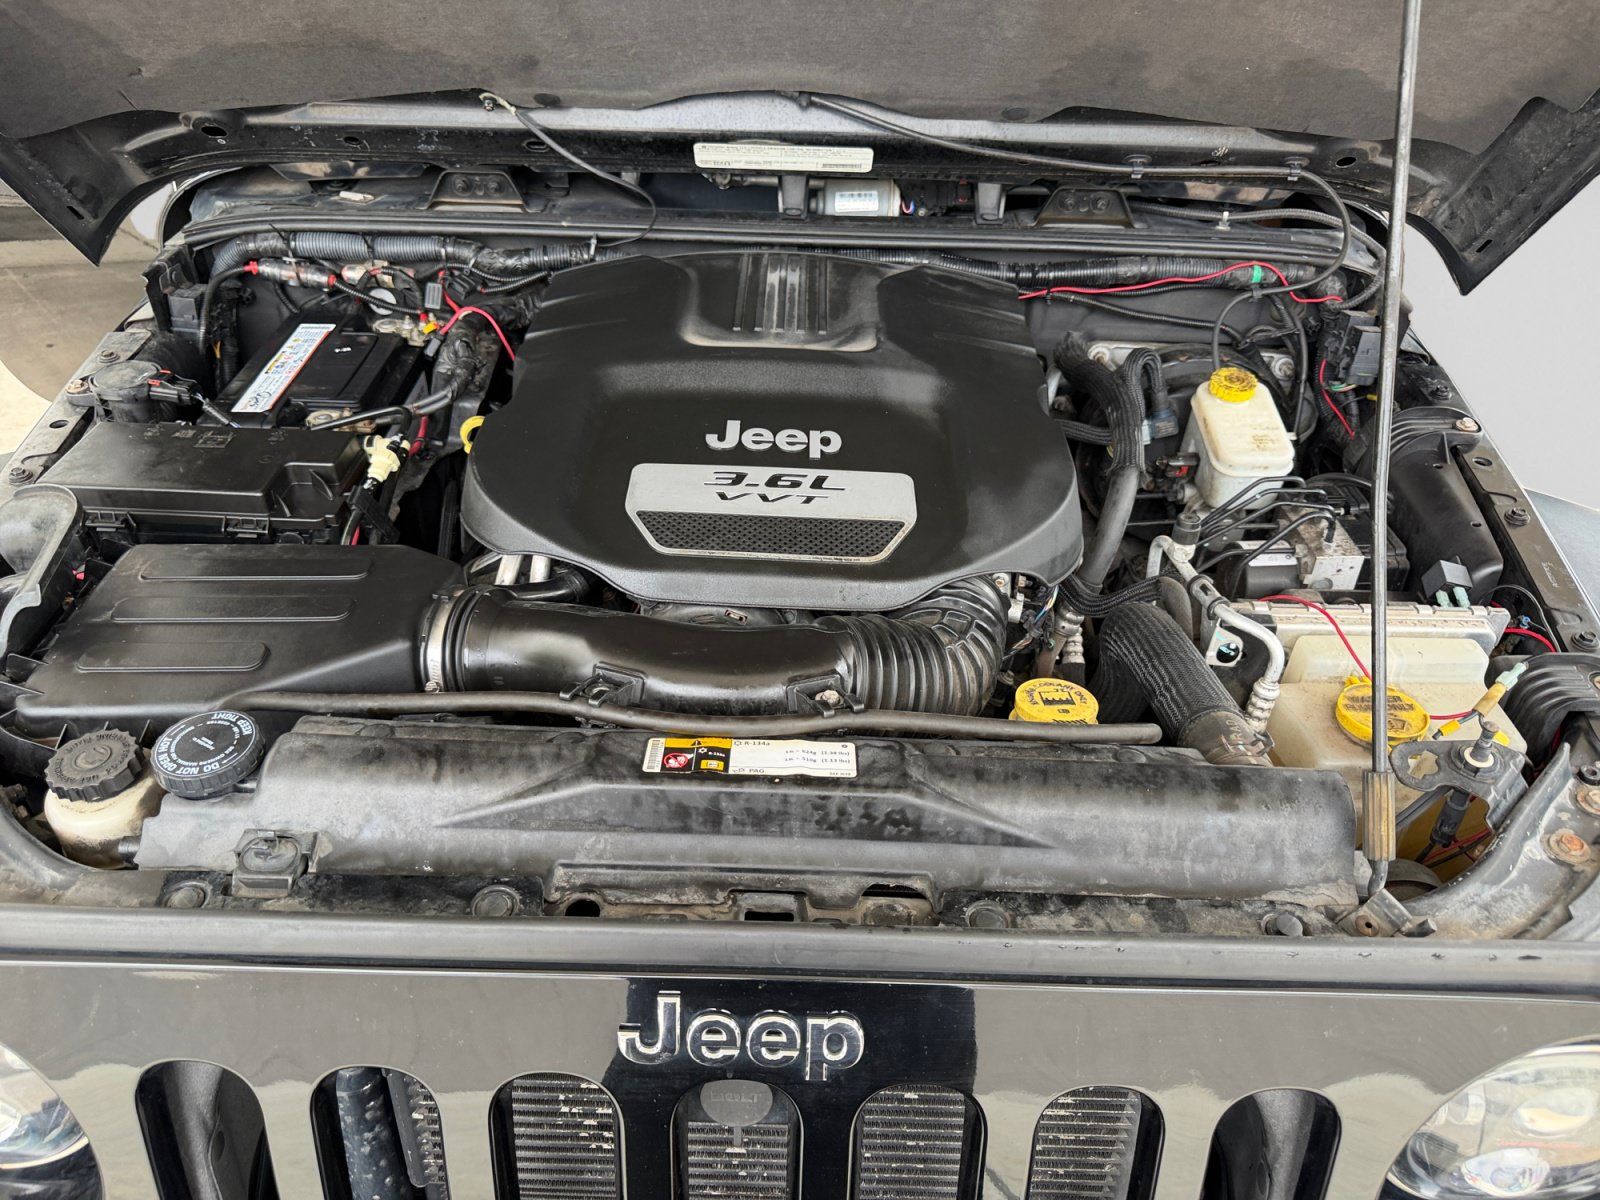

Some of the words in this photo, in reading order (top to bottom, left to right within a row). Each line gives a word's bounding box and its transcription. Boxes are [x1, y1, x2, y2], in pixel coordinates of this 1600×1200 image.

[705, 420, 842, 460] Jeep
[704, 471, 846, 491] 3.6L
[716, 491, 830, 505] VVT
[211, 712, 240, 721] TIGHT
[237, 719, 253, 736] KEEP
[157, 737, 173, 753] HOT
[157, 753, 178, 771] OPEN
[203, 762, 220, 773] DO
[175, 766, 199, 775] NOT
[617, 990, 865, 1081] Jeep
